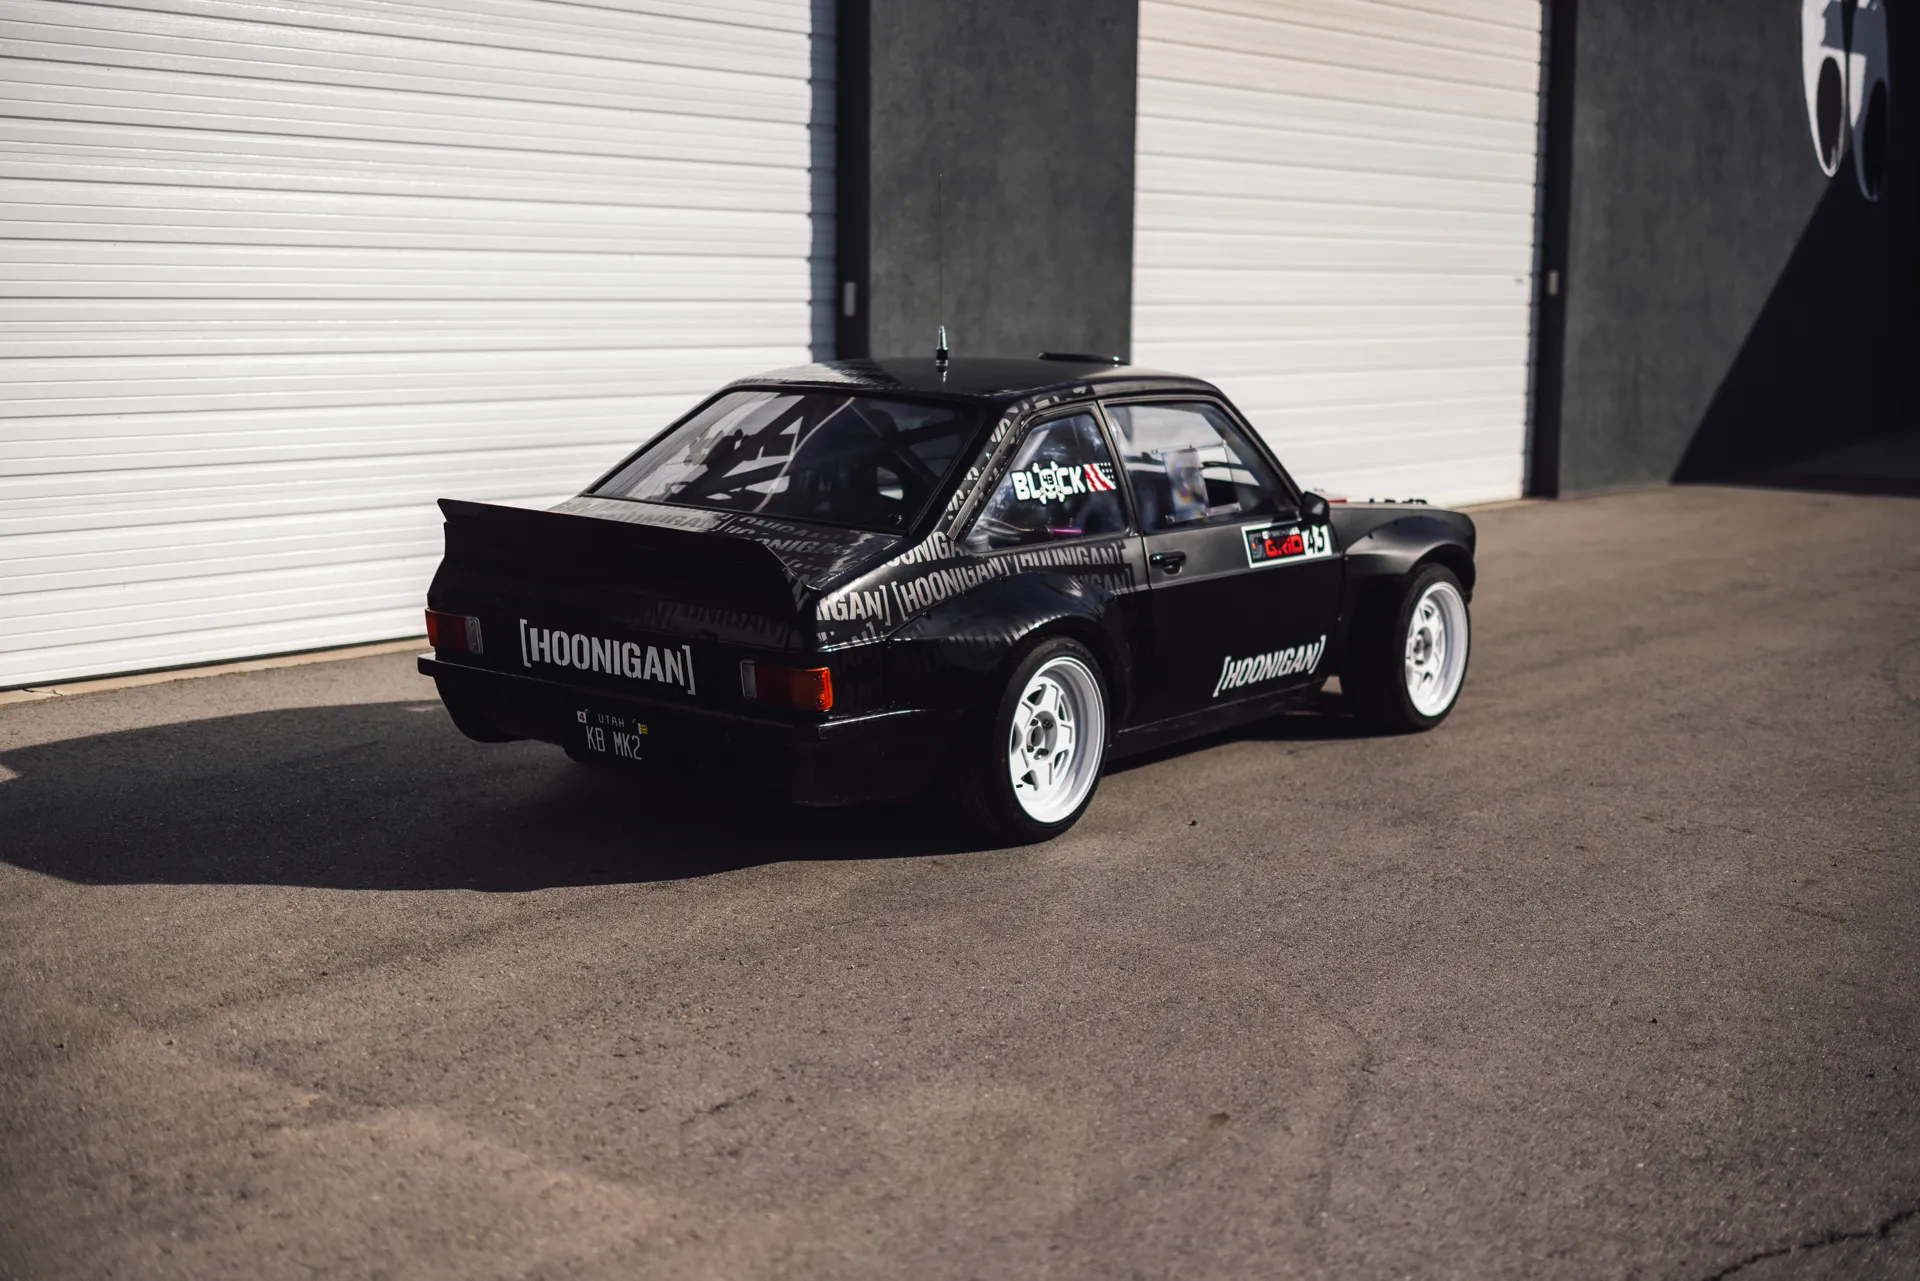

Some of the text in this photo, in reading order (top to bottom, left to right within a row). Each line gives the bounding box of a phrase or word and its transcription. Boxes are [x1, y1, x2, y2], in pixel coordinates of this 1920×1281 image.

[520, 618, 696, 696] [HOONIGAN]
[1212, 634, 1327, 698] [HOONIGAN]
[586, 725, 642, 760] KB MK2
[598, 714, 624, 727] UTAH
